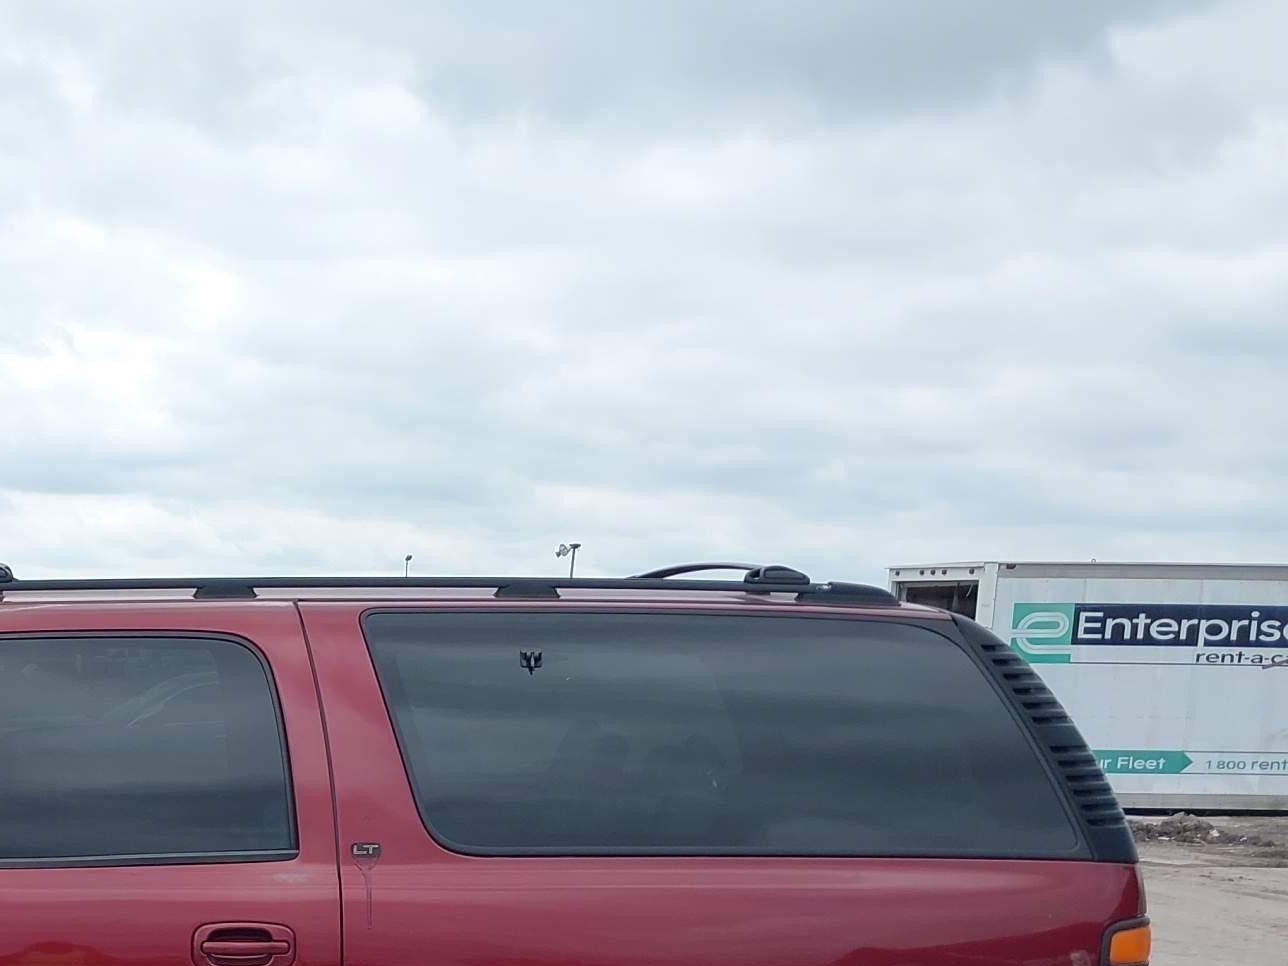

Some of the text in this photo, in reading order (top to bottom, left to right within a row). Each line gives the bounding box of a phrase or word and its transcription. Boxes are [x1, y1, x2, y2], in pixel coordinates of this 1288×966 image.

[1077, 610, 1288, 648] Enterpris
[1195, 651, 1288, 664] rent-a-c
[1117, 756, 1166, 770] Fleet
[1216, 760, 1247, 770] 800
[353, 844, 380, 855] LT
